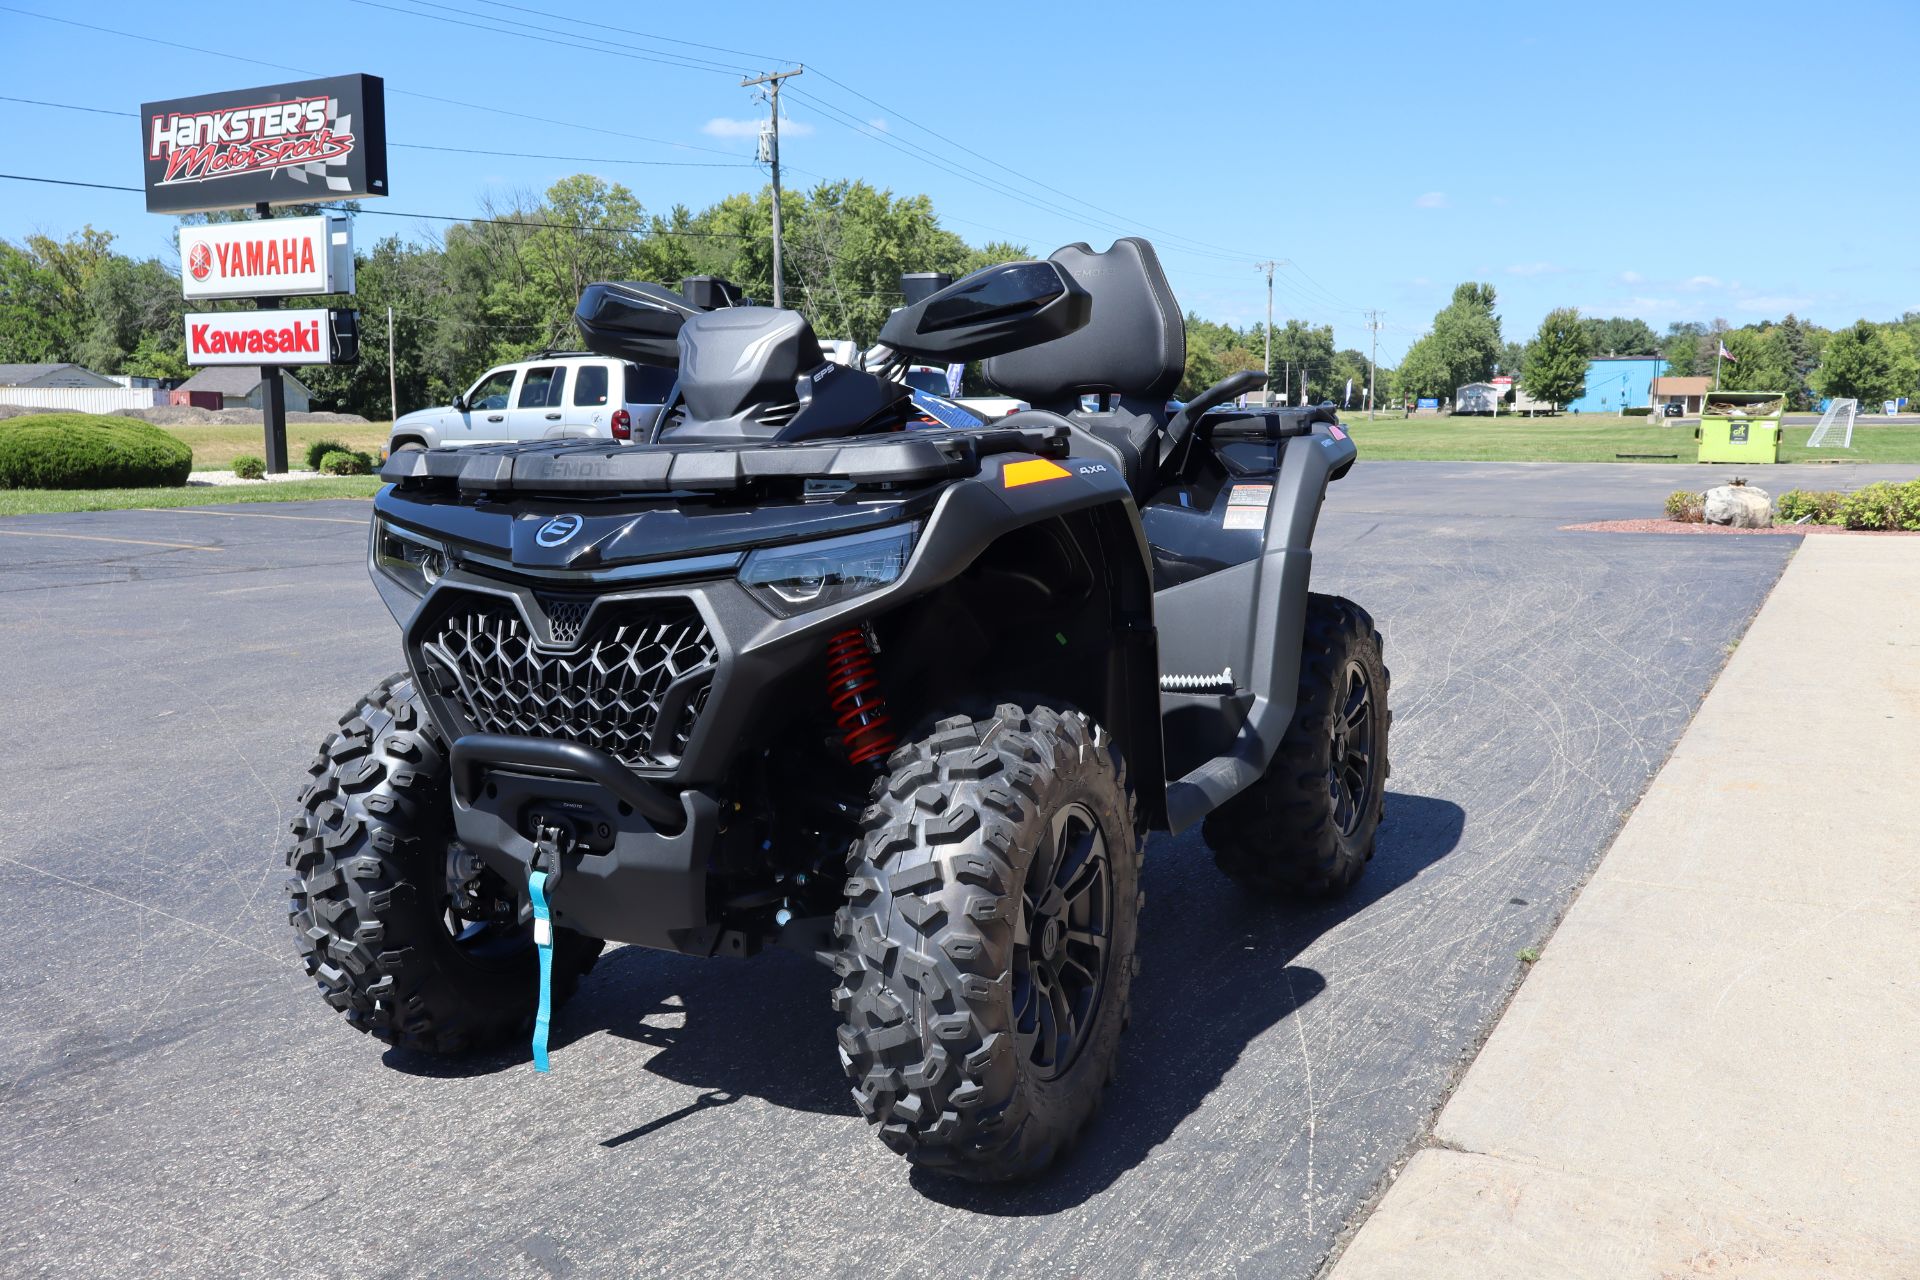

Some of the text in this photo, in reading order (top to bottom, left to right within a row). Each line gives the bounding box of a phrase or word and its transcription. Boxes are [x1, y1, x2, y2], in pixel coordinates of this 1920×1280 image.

[215, 237, 315, 278] YAMAHA
[191, 320, 320, 354] Kawasaki
[813, 363, 835, 383] EPS
